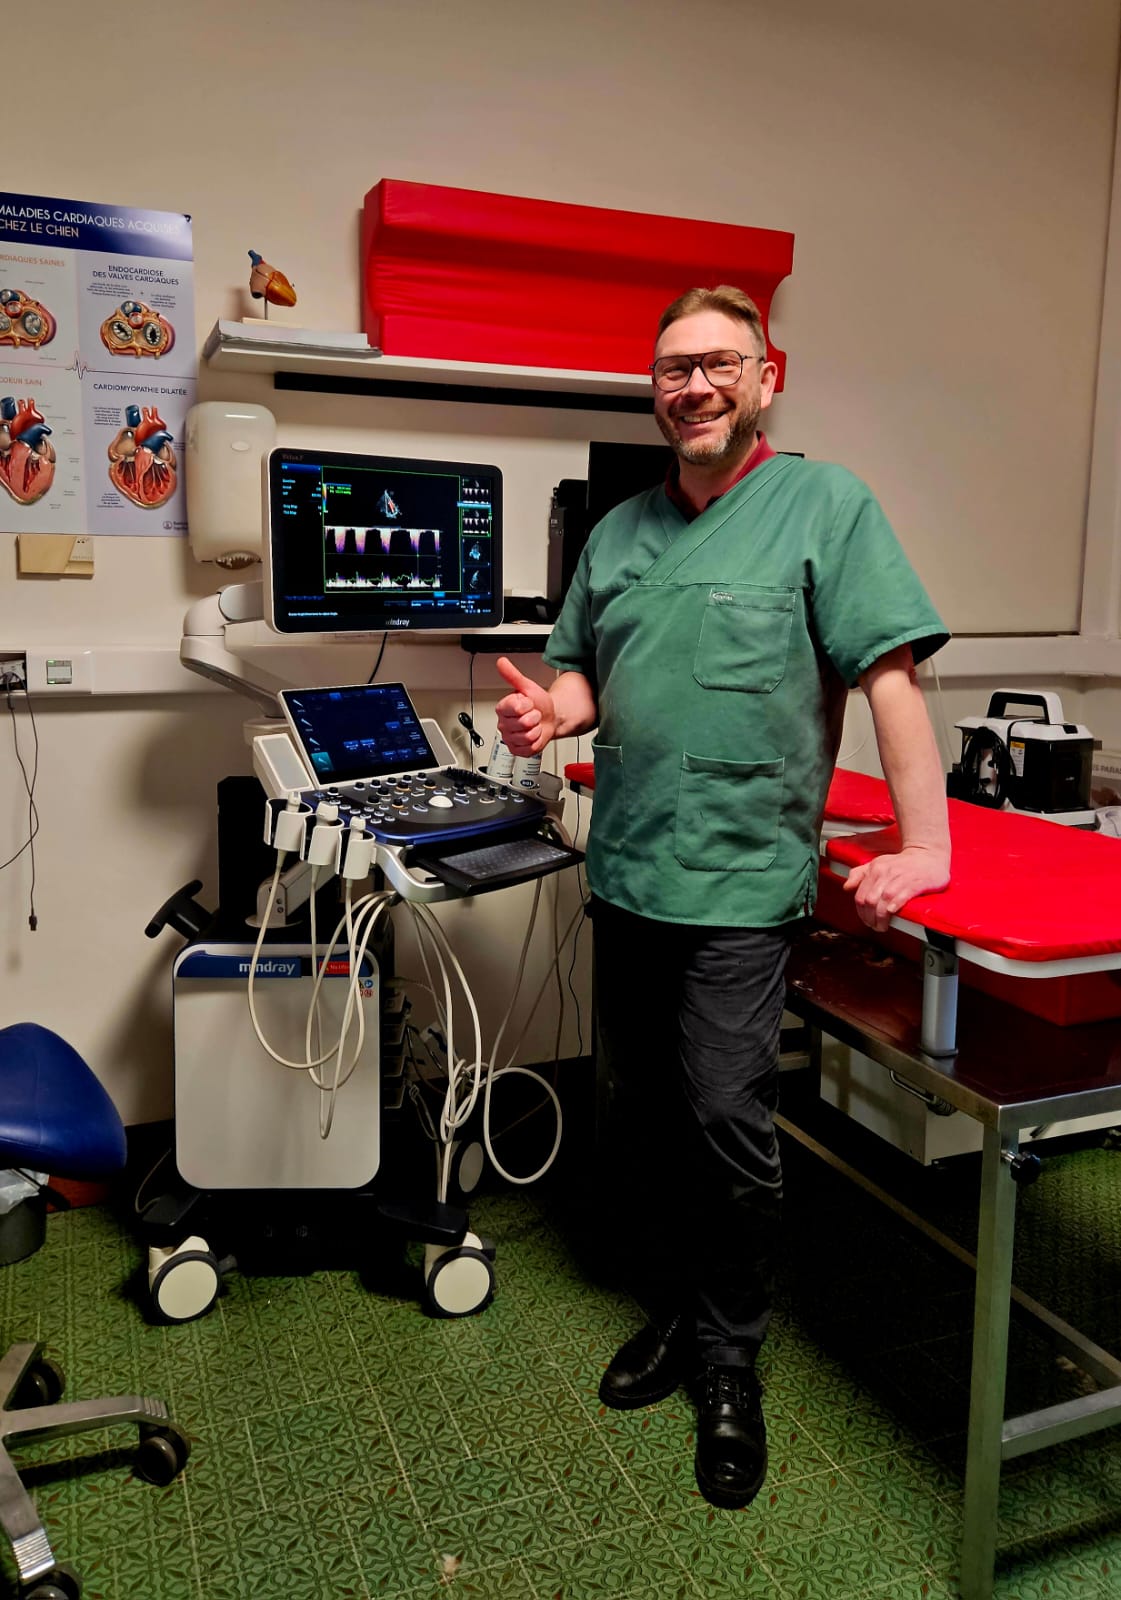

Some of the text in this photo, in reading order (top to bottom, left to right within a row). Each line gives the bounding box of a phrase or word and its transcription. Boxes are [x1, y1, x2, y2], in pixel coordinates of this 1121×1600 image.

[53, 211, 124, 229] CARDIAQUES
[30, 222, 43, 234] LE
[45, 224, 79, 238] CHIEN
[92, 270, 179, 286] DES VALVES CARDIAQUES
[108, 265, 164, 277] ENDOCARDIOSE
[93, 383, 159, 394] CARDIOMYOPATHIE
[239, 960, 296, 976] mndray
